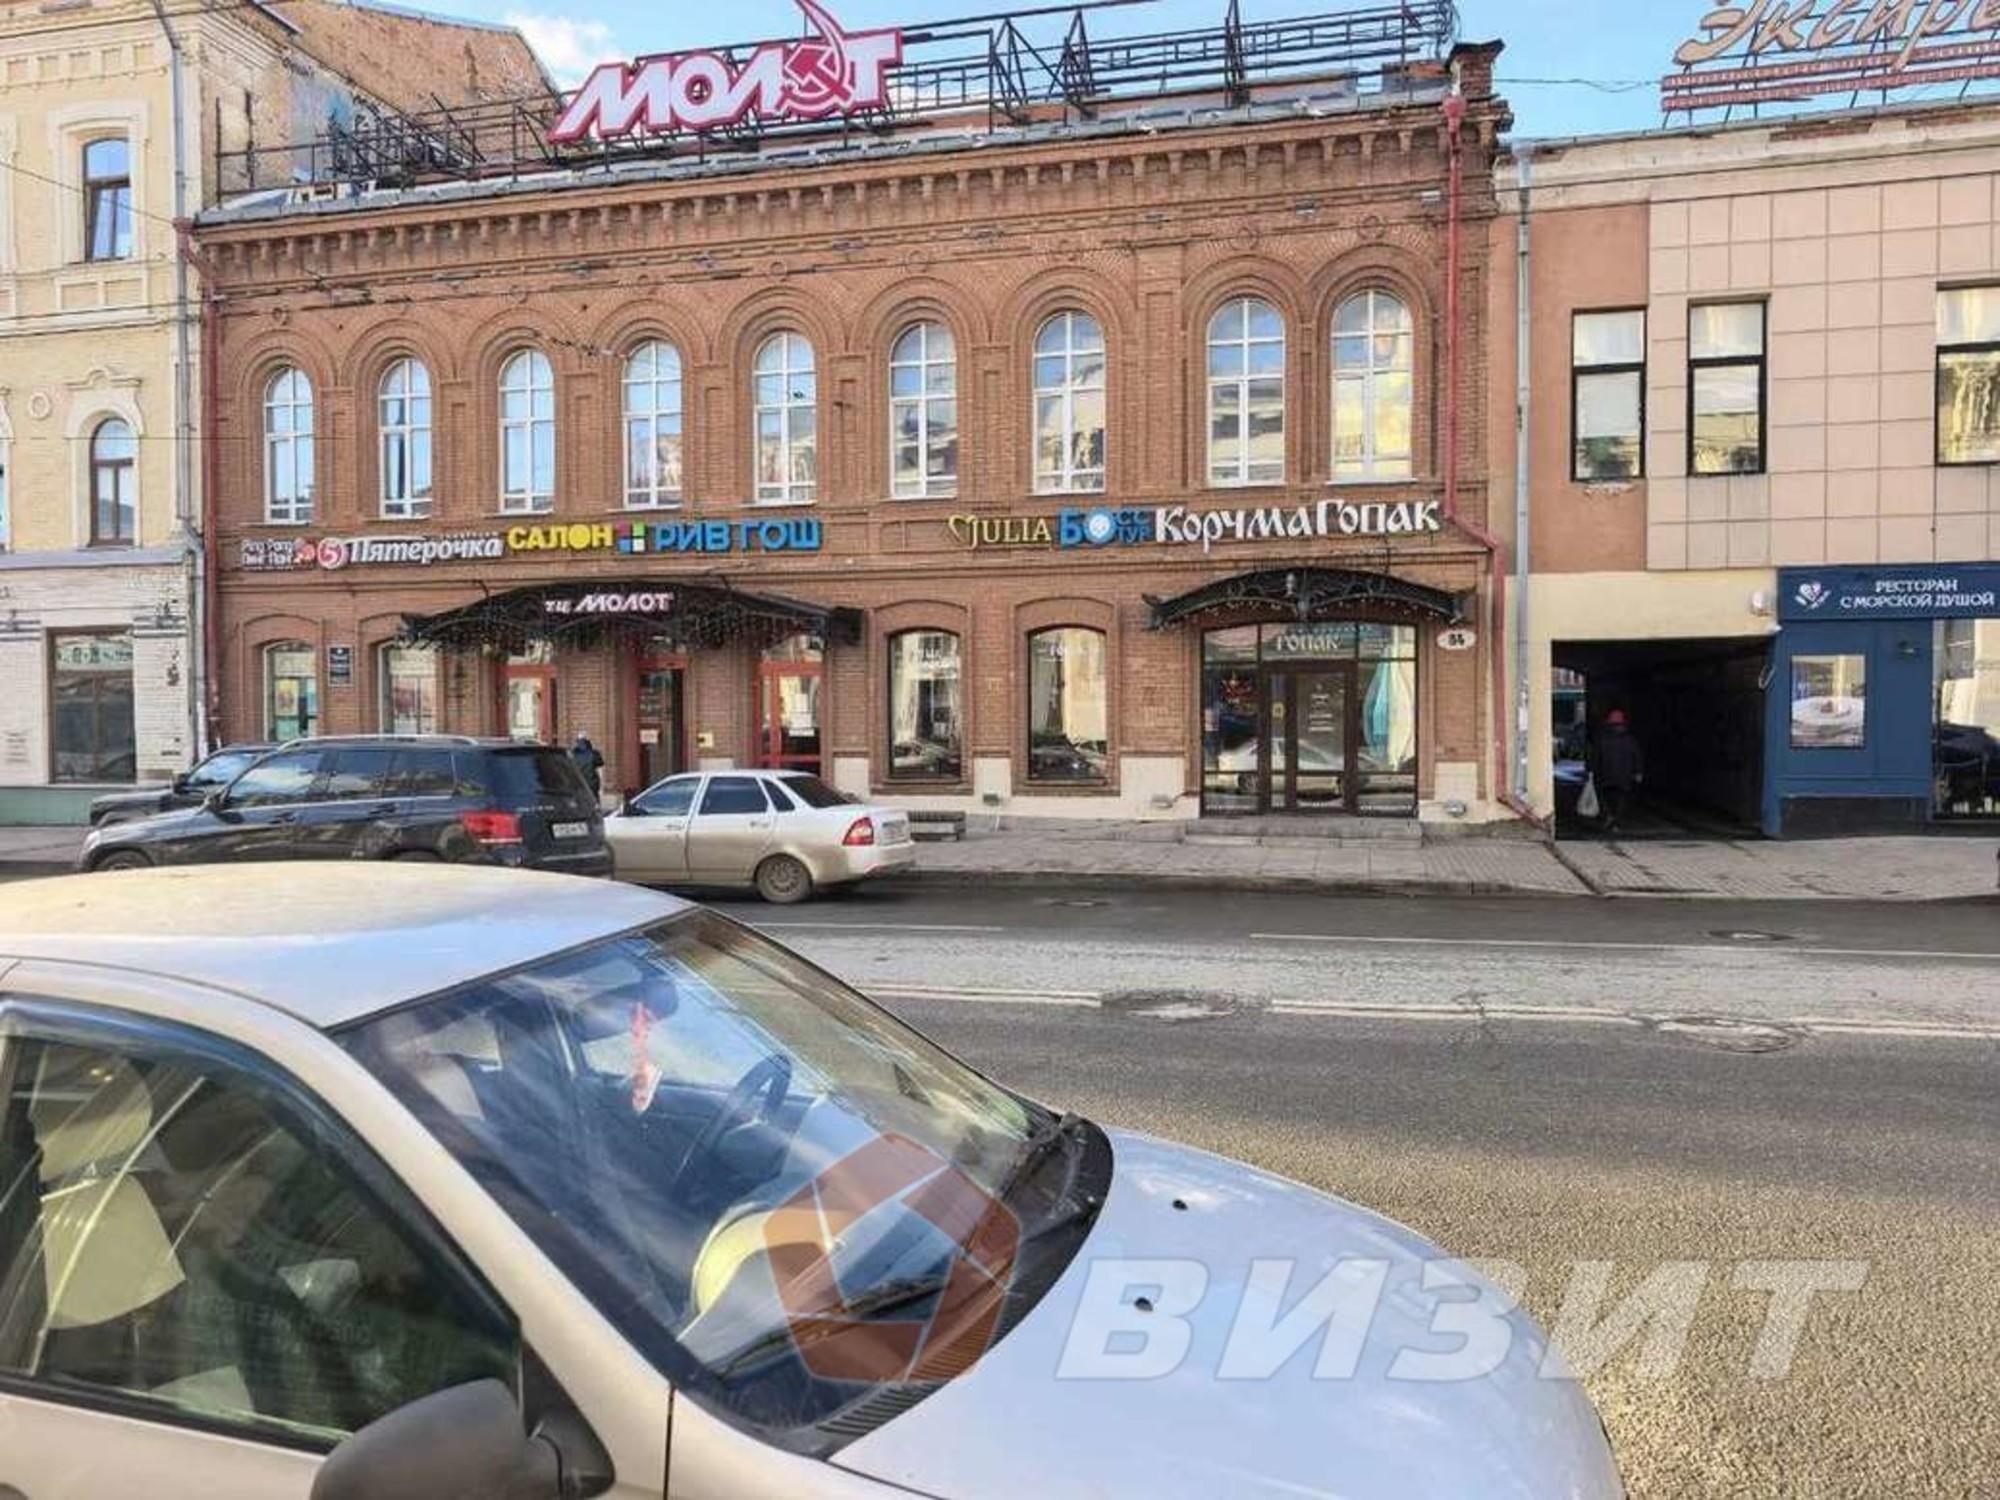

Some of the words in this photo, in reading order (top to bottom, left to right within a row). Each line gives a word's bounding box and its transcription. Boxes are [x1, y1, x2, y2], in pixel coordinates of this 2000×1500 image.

[507, 523, 615, 550] САЛОН
[655, 521, 730, 555] РИВ
[740, 518, 823, 551] ГОШ
[948, 514, 1052, 550] JULIA
[349, 535, 503, 564] Пятерочка
[1853, 594, 1933, 608] МОРСКОЙ
[1934, 591, 1995, 607] ДУШОЙ
[1875, 579, 1958, 593] РЕСТОРАН
[574, 592, 675, 612] МОЛОТ
